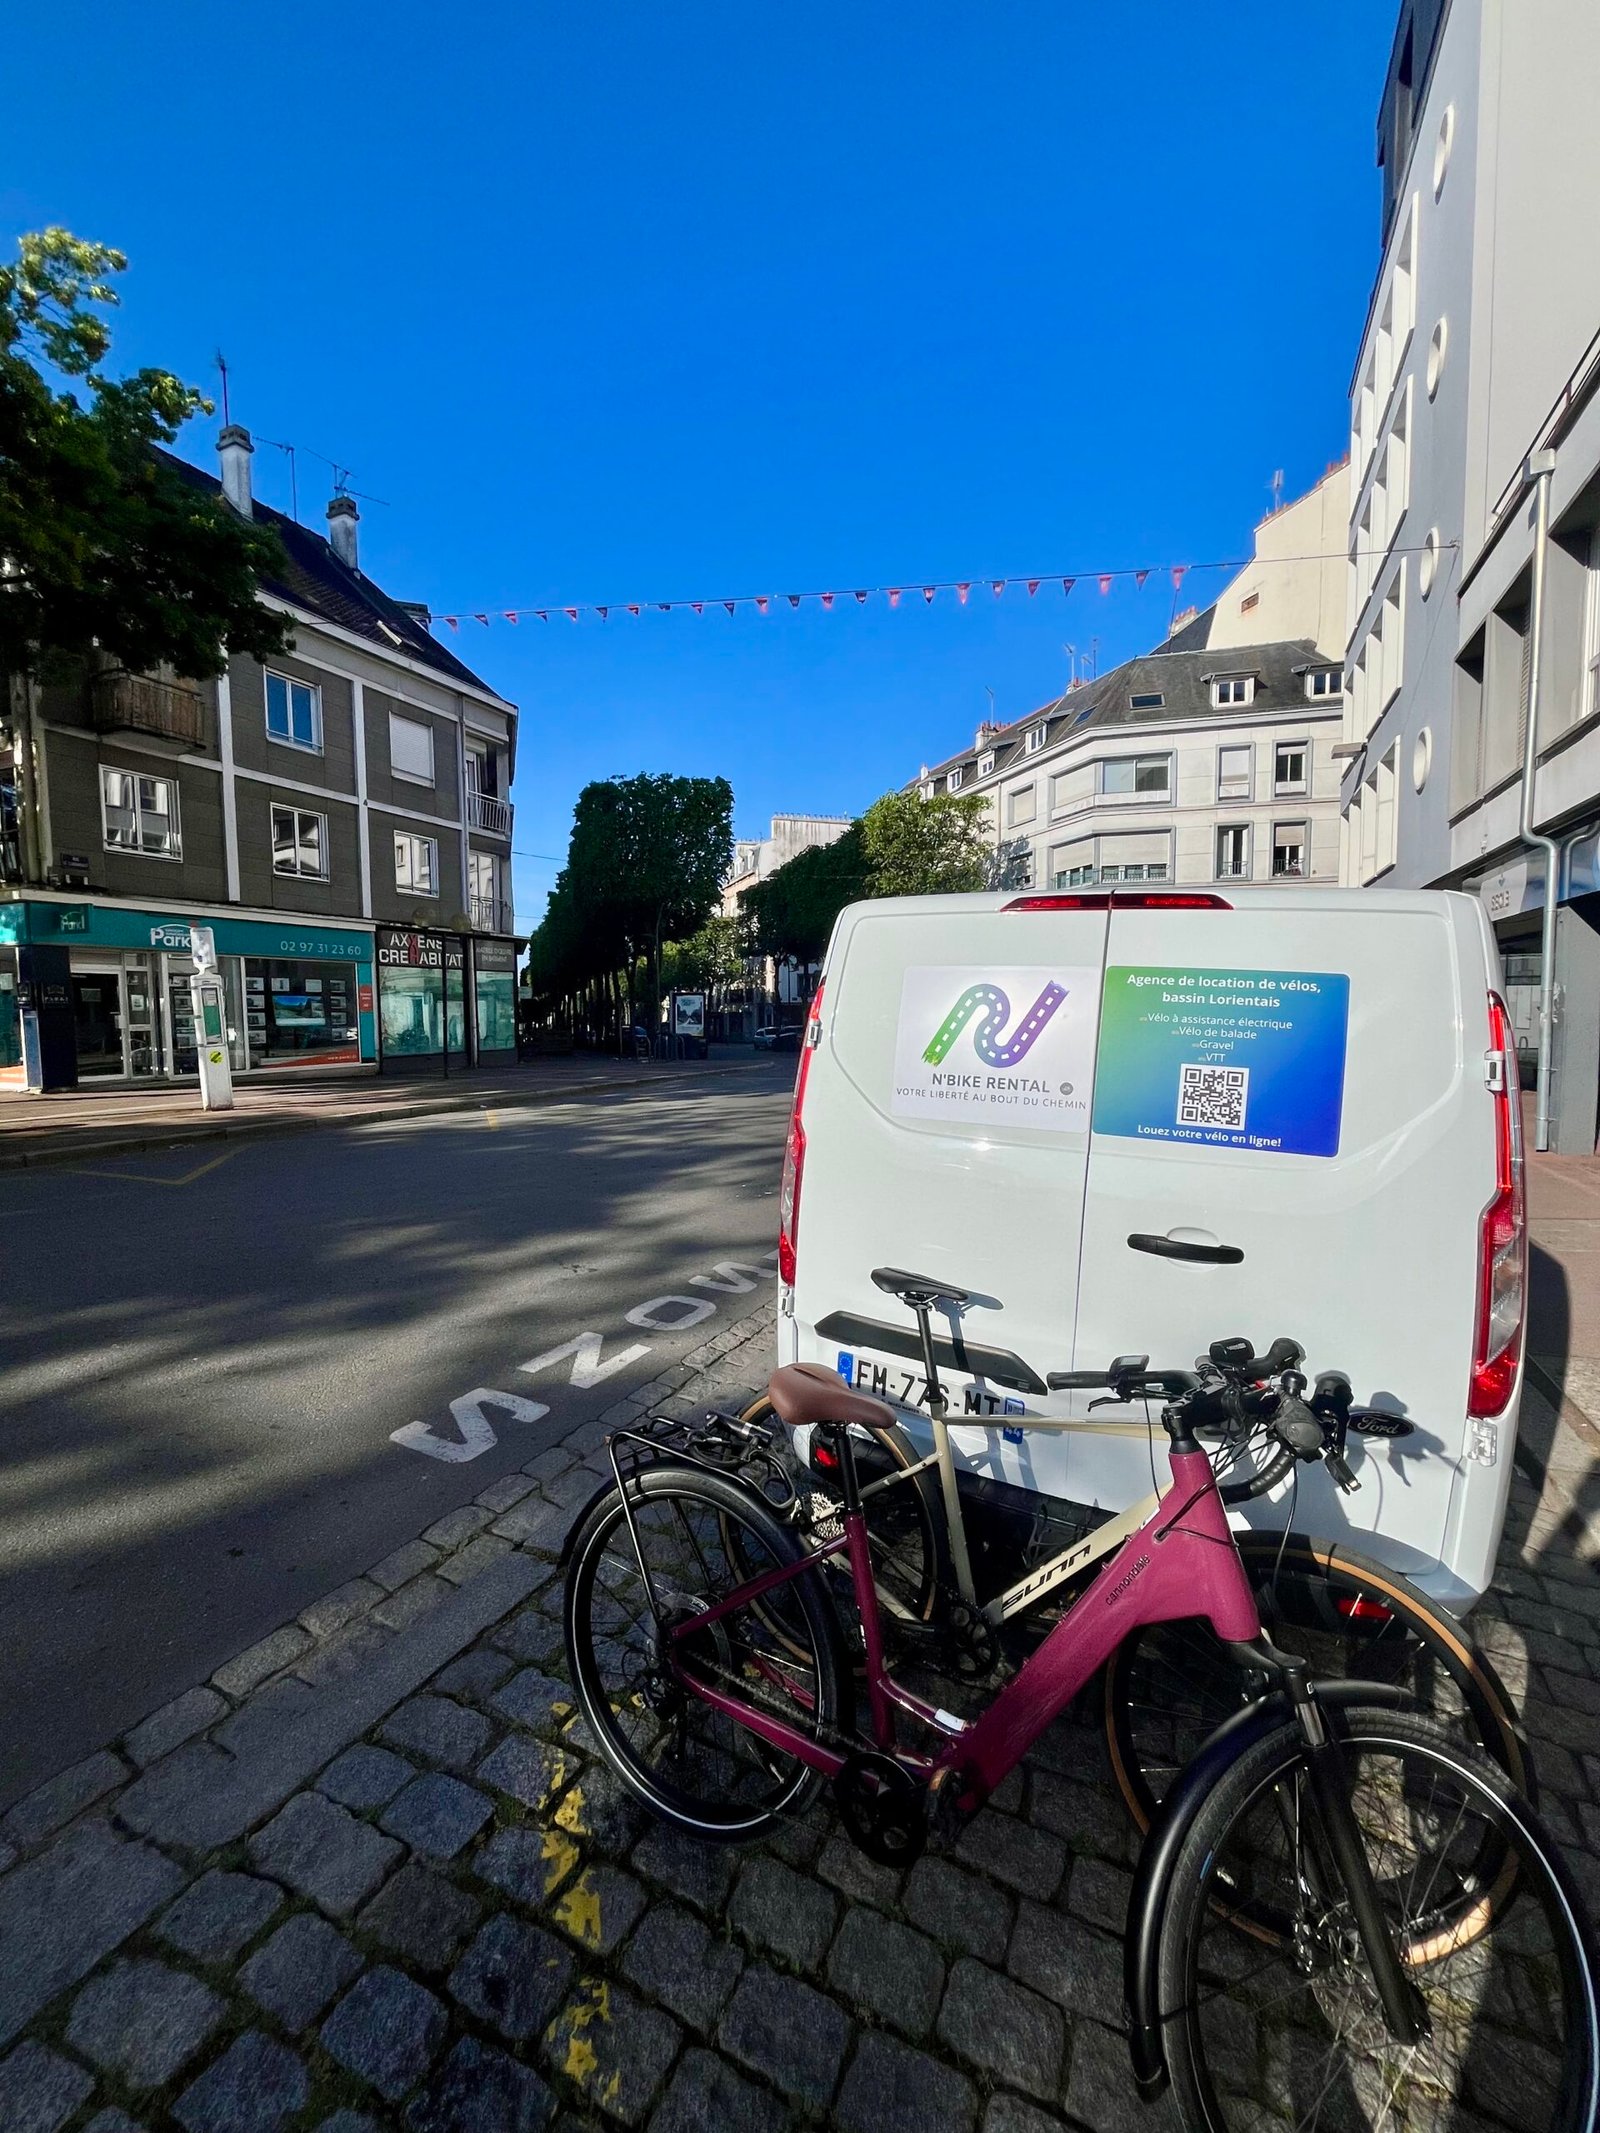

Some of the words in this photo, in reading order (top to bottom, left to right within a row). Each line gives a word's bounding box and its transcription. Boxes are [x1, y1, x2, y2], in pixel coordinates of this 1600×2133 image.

[150, 927, 194, 948] Park
[280, 940, 295, 951] 02
[299, 942, 314, 953] 97
[317, 944, 329, 954] 31
[331, 944, 345, 955] 23
[347, 945, 361, 956] 60
[1126, 974, 1175, 988] Agence
[1178, 975, 1195, 987] de
[1198, 976, 1255, 989] location
[1258, 978, 1276, 990] de
[1279, 978, 1321, 994] vélos,
[1162, 992, 1205, 1004] bassin
[1209, 994, 1281, 1008] Lorientais
[1147, 1013, 1170, 1023] Vélo
[1172, 1014, 1179, 1023] à
[1181, 1014, 1236, 1026] assistance
[1238, 1017, 1293, 1030] électrique
[1179, 1026, 1202, 1036] Vélo
[1204, 1027, 1218, 1037] de
[1220, 1028, 1257, 1039] balade
[1199, 1040, 1234, 1050] Gravel
[1205, 1053, 1226, 1062] VTT
[932, 1073, 982, 1088] N'BIKE
[986, 1077, 1051, 1093] RENTAL
[896, 1087, 926, 1098] VOTRE
[930, 1091, 969, 1101] LIBERTÉ
[972, 1093, 987, 1102] AU
[990, 1095, 1019, 1105] BOUT
[1023, 1097, 1039, 1106] DU
[1042, 1098, 1087, 1110] CHEMIN
[1137, 1124, 1169, 1136] Louez
[1172, 1129, 1202, 1139] votre
[1205, 1131, 1229, 1142] vélo
[1231, 1135, 1246, 1144] en
[1249, 1135, 1282, 1147] ligne!
[1357, 1414, 1399, 1435] Ford
[1105, 1554, 1151, 1606] cannondale
